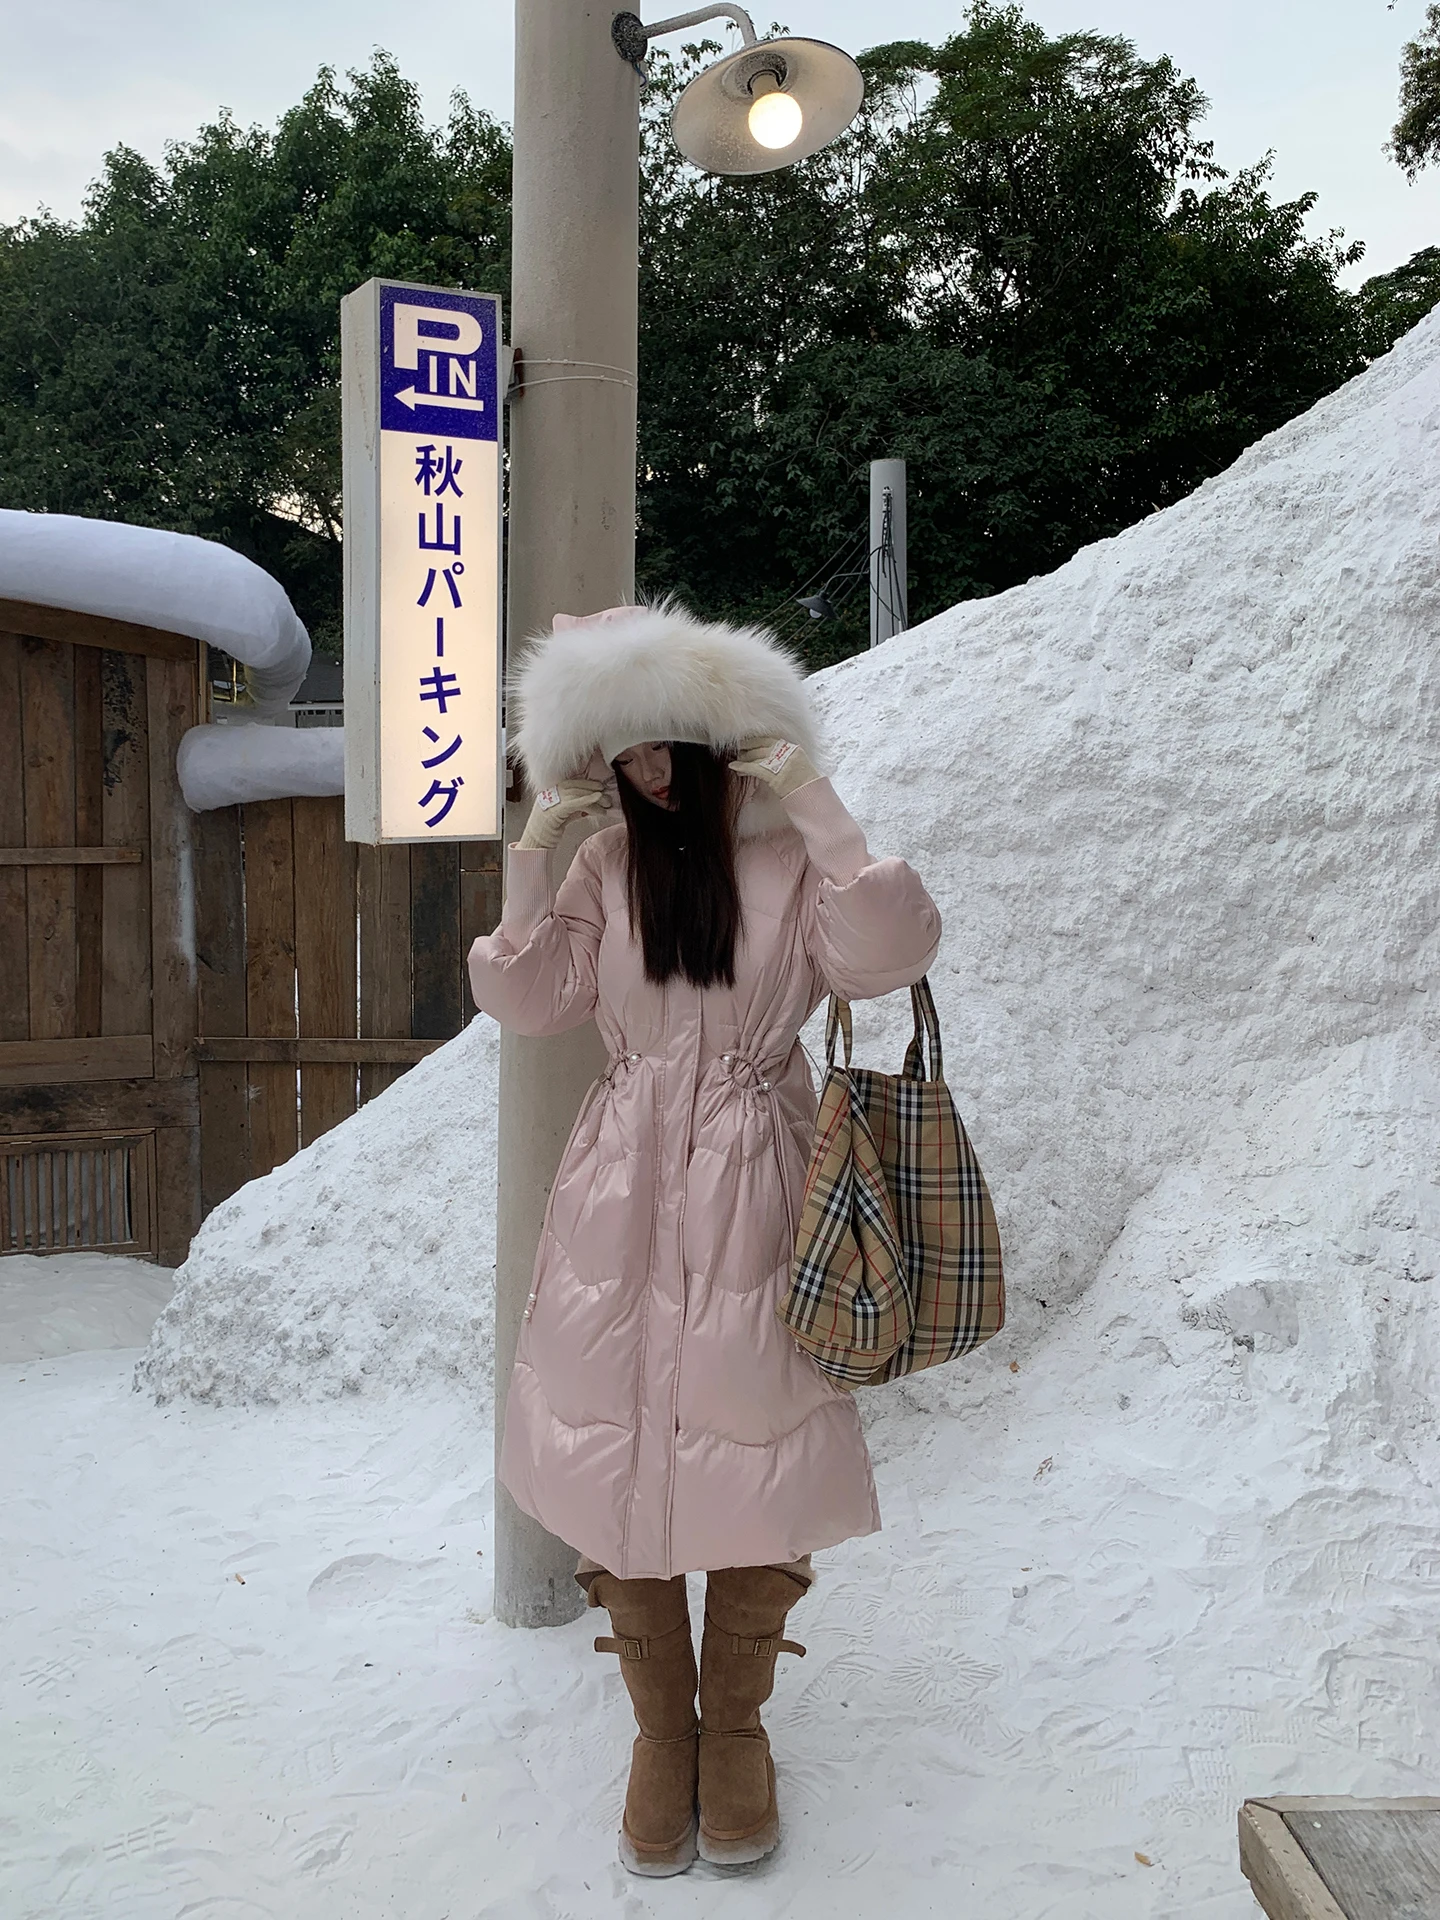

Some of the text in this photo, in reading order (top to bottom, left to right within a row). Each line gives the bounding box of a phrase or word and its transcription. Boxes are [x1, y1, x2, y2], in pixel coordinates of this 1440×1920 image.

[394, 303, 482, 370] P
[429, 355, 476, 397] IN
[415, 444, 464, 827] 秋山パーキング
